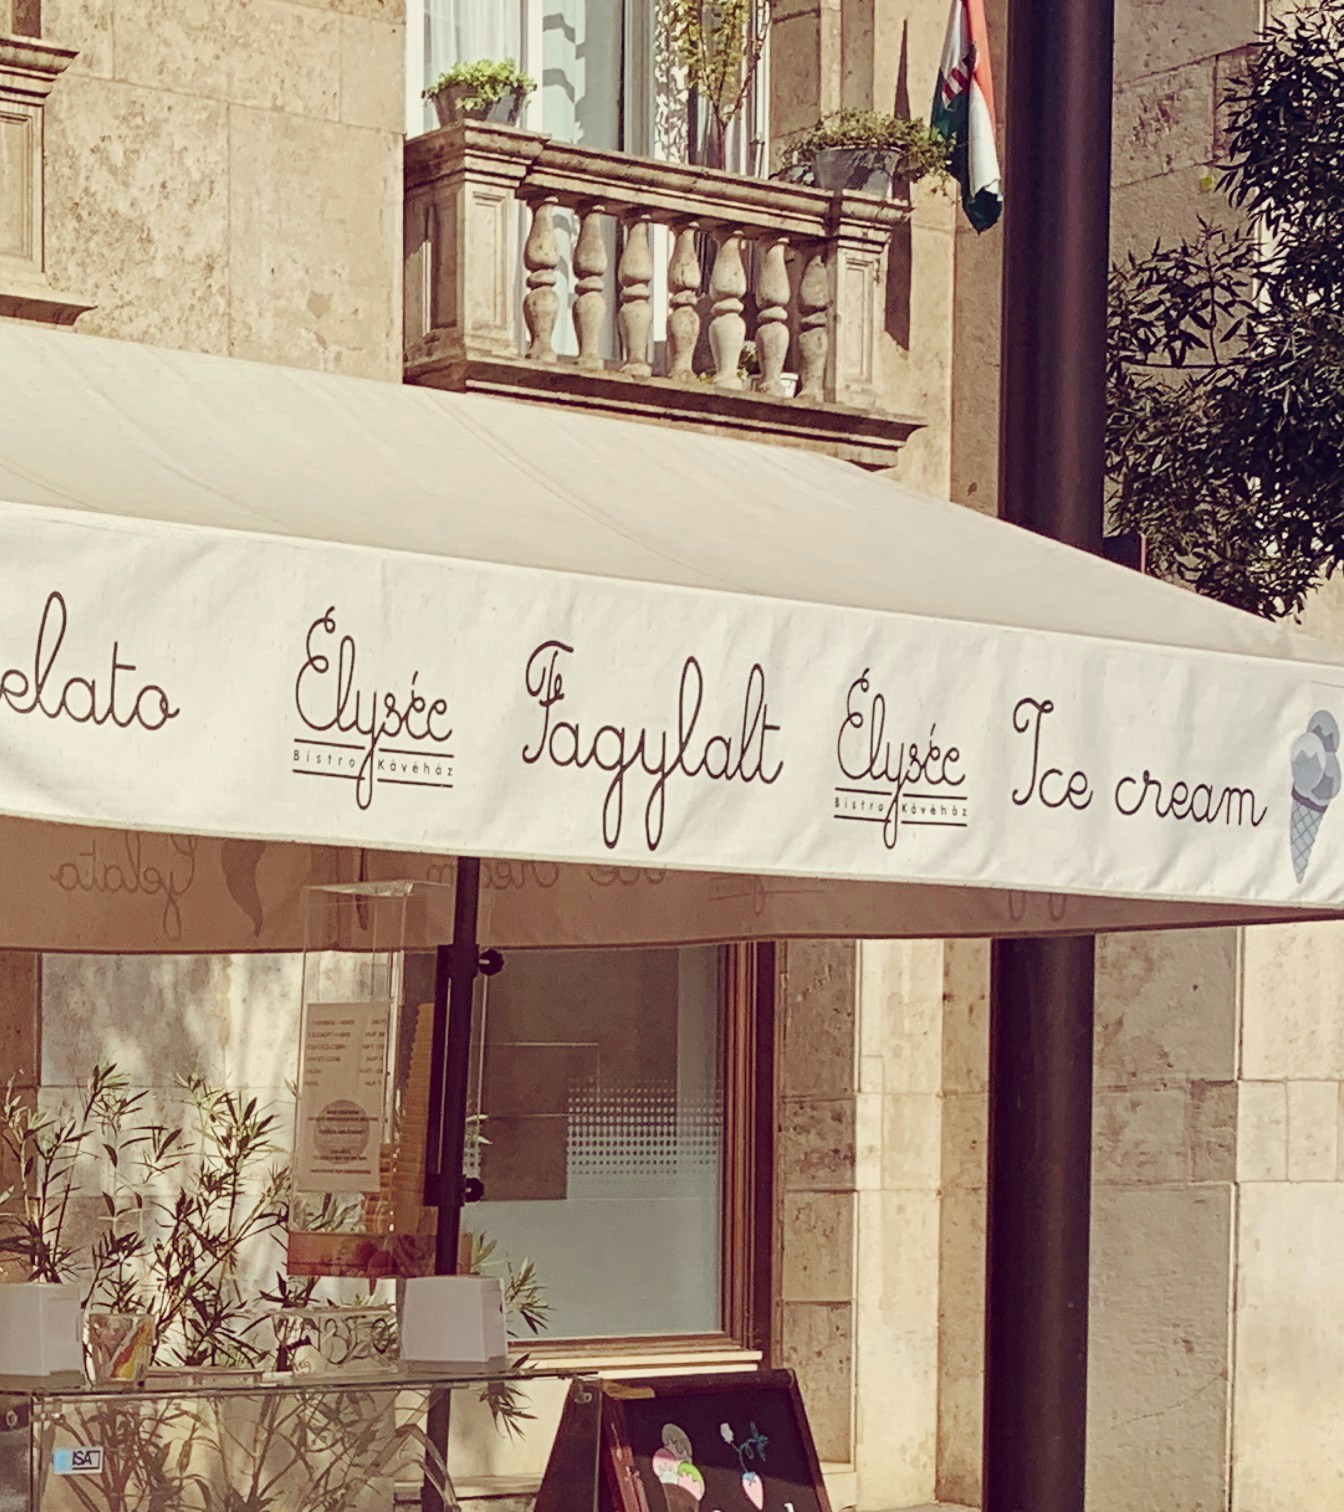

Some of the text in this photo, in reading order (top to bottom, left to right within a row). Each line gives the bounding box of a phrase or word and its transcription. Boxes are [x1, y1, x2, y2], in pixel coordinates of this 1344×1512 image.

[521, 640, 784, 851] Fagylalt
[1012, 698, 1093, 807] Ice
[1115, 768, 1268, 828] cream
[293, 749, 454, 776] Bistro Kávéház
[835, 797, 883, 811] Bistro
